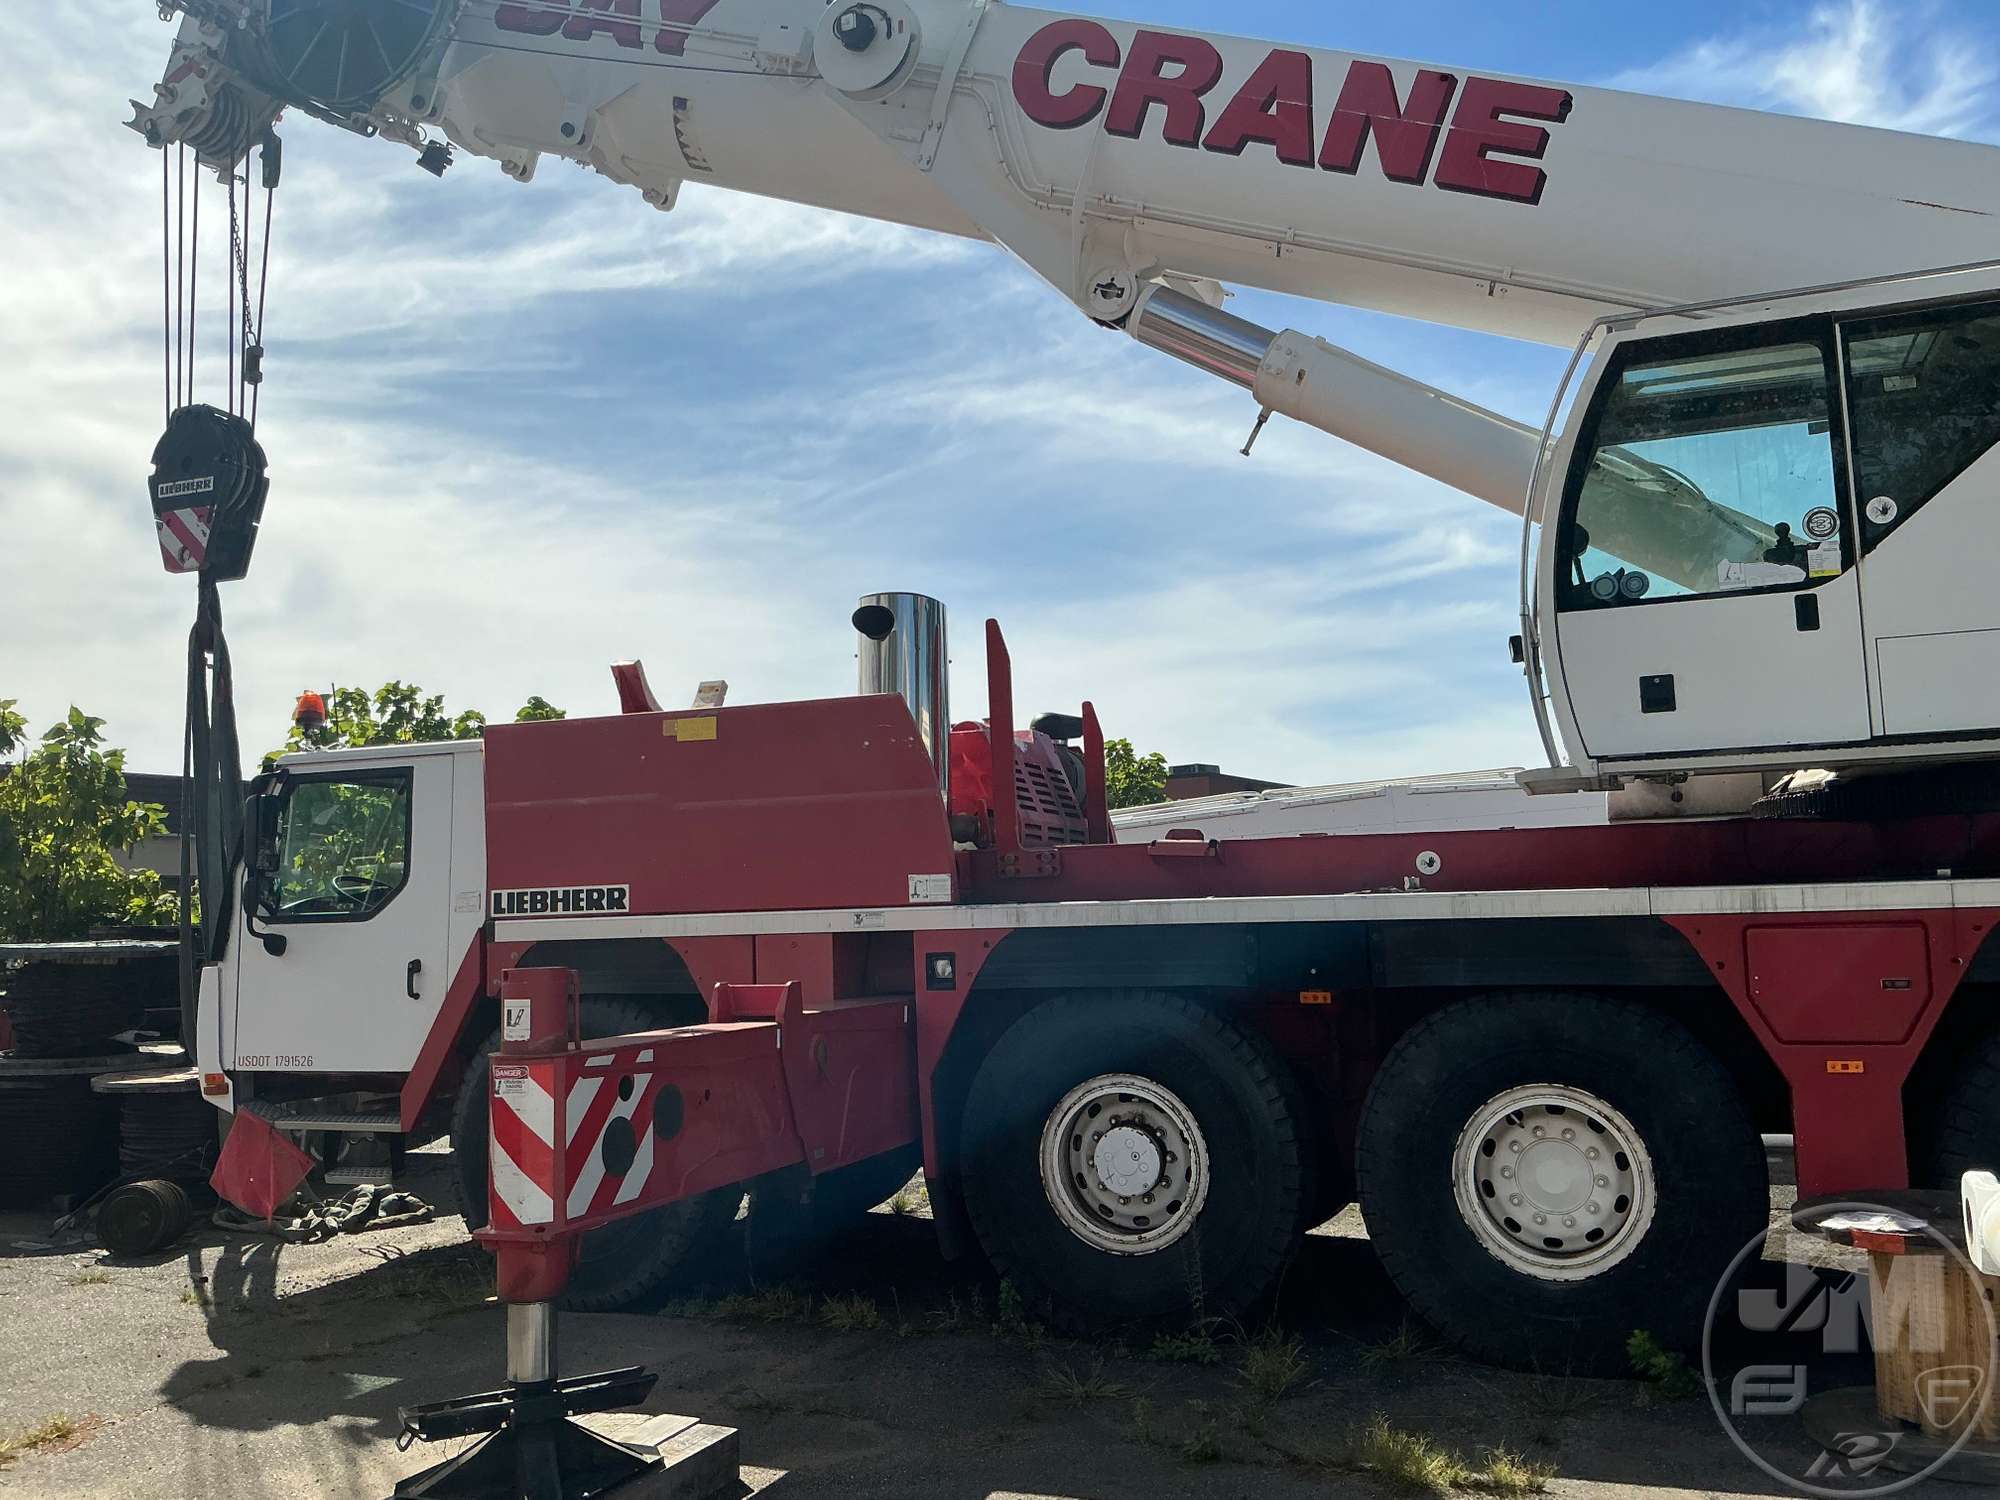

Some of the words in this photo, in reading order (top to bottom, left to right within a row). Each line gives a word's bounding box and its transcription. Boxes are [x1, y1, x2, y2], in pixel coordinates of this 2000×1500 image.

[1012, 18, 1573, 206] CRANE
[159, 477, 212, 496] LIEBHERR
[493, 887, 627, 914] LIEBHERR
[238, 1055, 271, 1067] USDOT
[275, 1055, 313, 1067] 1791526
